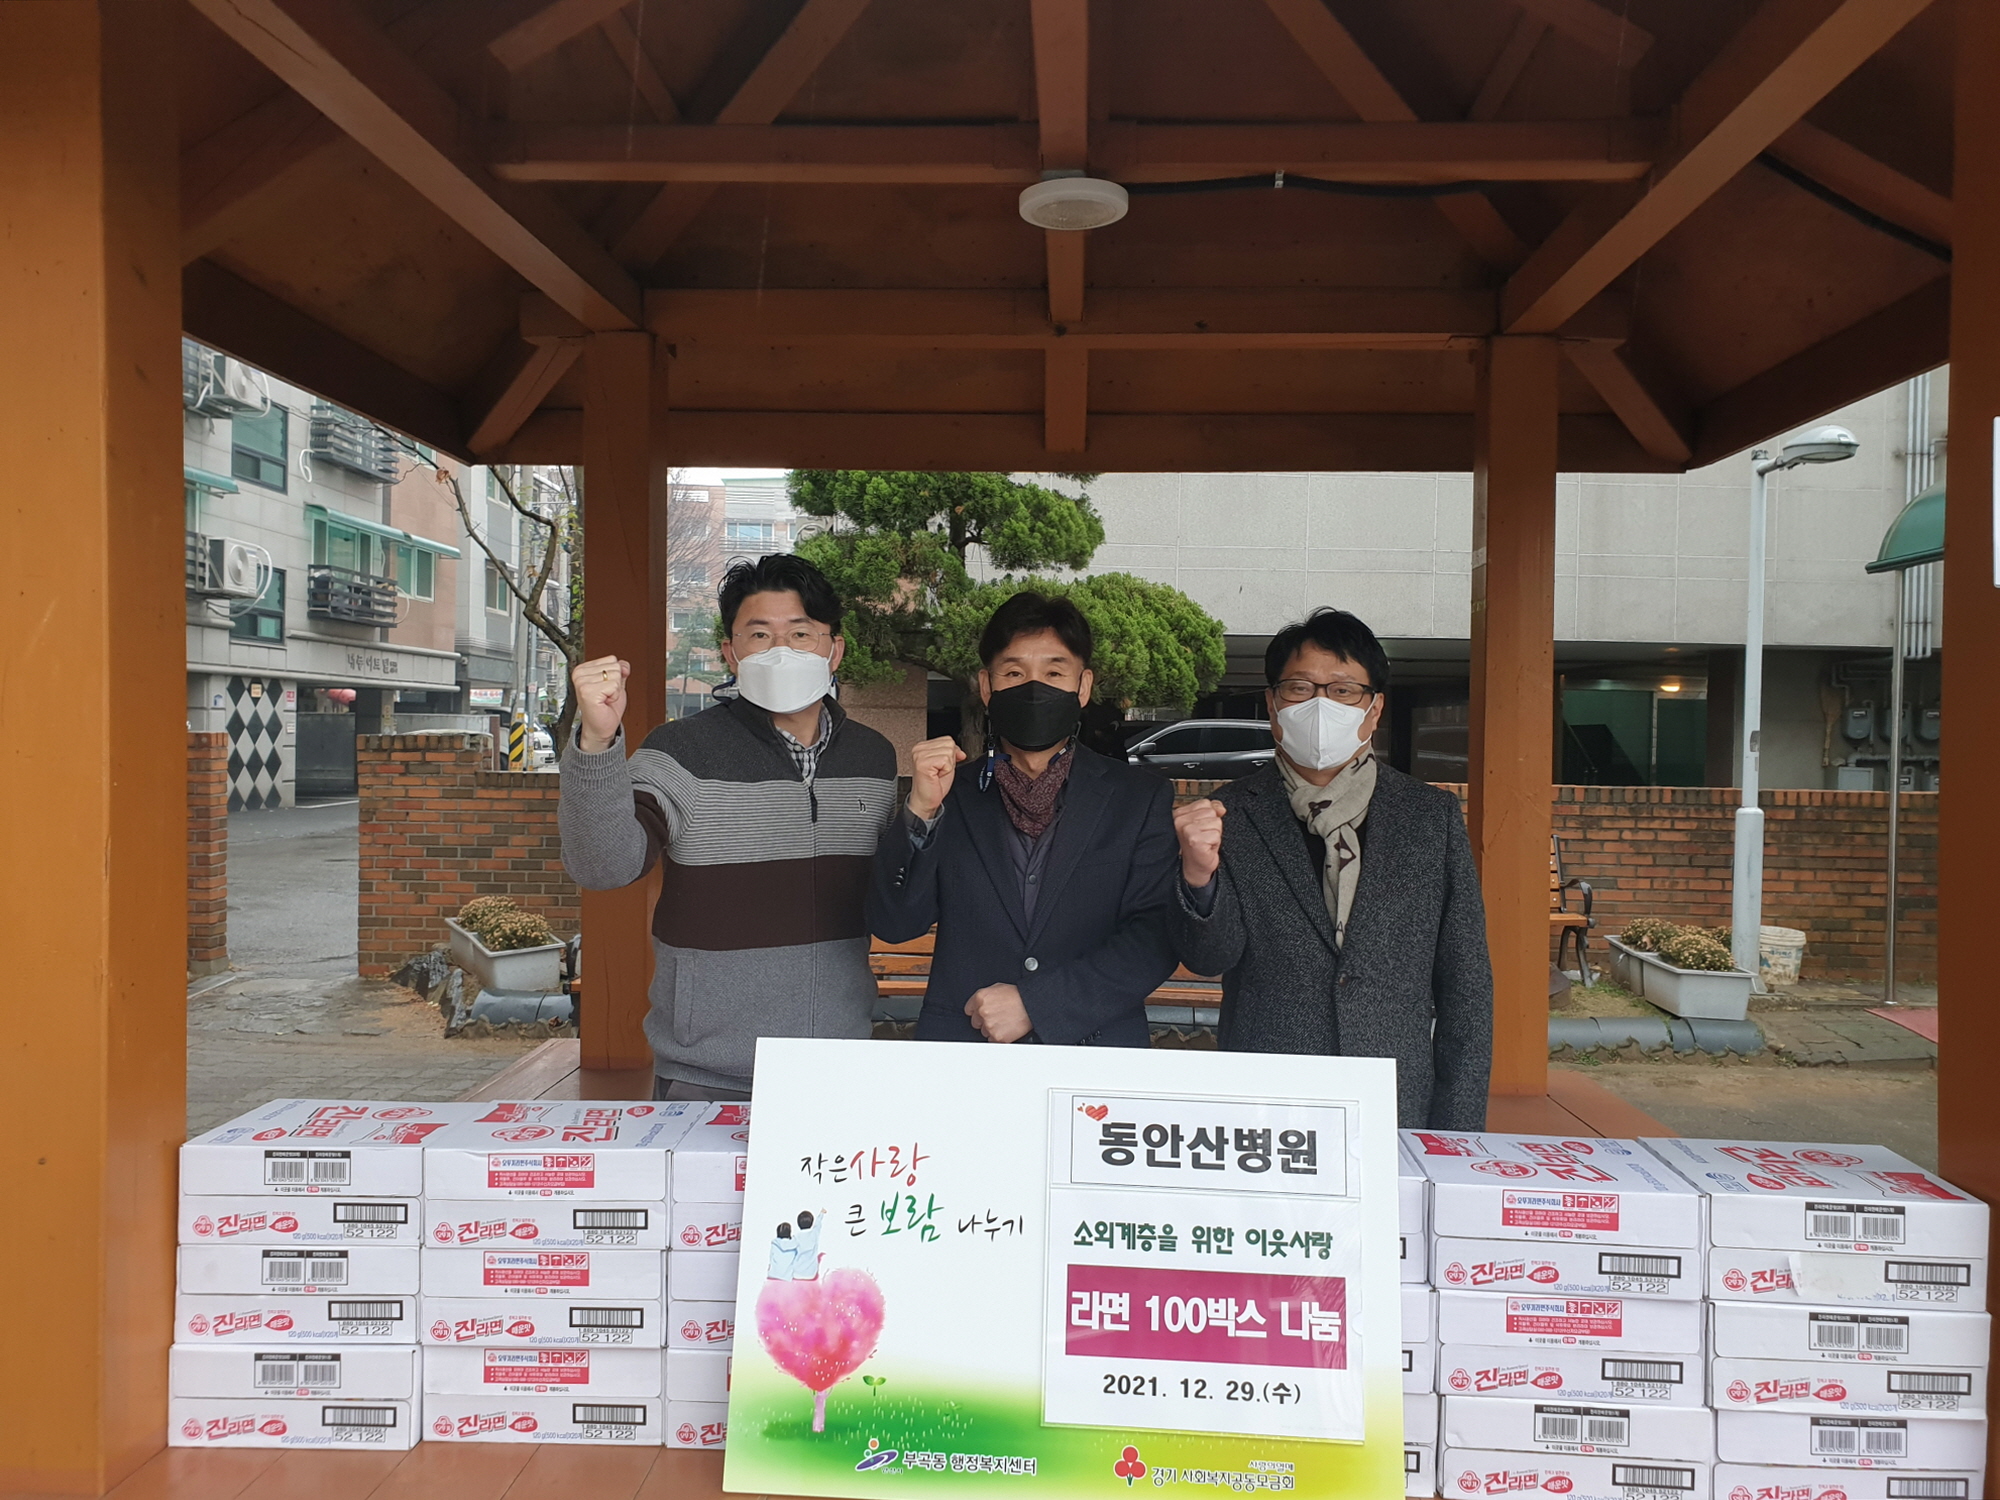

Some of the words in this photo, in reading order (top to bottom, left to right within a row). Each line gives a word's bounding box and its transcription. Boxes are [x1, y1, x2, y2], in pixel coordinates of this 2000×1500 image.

[1098, 1122, 1318, 1175] 동안산병원
[844, 1204, 867, 1237] 큰
[880, 1191, 945, 1243] 보람
[958, 1208, 1024, 1242] 나누기
[346, 1228, 364, 1238] 52
[370, 1228, 395, 1238] 122
[457, 1221, 508, 1243] 진라면
[586, 1235, 604, 1244] 52
[610, 1235, 635, 1244] 122
[1073, 1220, 1178, 1252] 소외계층을
[1191, 1225, 1234, 1255] 위한
[1245, 1228, 1333, 1260] 이웃사랑
[1470, 1260, 1525, 1285] 진라면
[1612, 1282, 1632, 1291] 52
[1638, 1283, 1666, 1293] 122
[1900, 1290, 1919, 1299] 52
[1926, 1291, 1955, 1300] 122
[1071, 1291, 1130, 1331] 라면
[1145, 1295, 1268, 1338] 100박스
[1280, 1301, 1342, 1342] 나눔
[341, 1326, 359, 1335] 52
[365, 1326, 390, 1335] 122
[454, 1318, 504, 1342] 진라면
[582, 1333, 600, 1342] 52
[605, 1333, 630, 1342] 122
[1103, 1374, 1167, 1397] 2021.
[1180, 1378, 1214, 1400] 12.
[1225, 1380, 1301, 1405] 29.(수)
[1474, 1367, 1529, 1392] 진라면
[1615, 1388, 1634, 1398] 52
[1642, 1389, 1669, 1399] 122
[1754, 1379, 1810, 1404] 진라면
[1901, 1400, 1922, 1409] 52
[1929, 1400, 1956, 1410] 122
[335, 1432, 352, 1441] 52
[358, 1432, 384, 1442] 122
[458, 1414, 507, 1437] 진라면
[585, 1429, 603, 1438] 52
[608, 1429, 633, 1438] 122
[903, 1451, 946, 1471] 부곡동
[951, 1454, 1037, 1476] 행정복지센터
[1152, 1467, 1177, 1487] 경기
[1181, 1469, 1295, 1492] 사회복지공동모금회
[1484, 1470, 1539, 1495] 진라면
